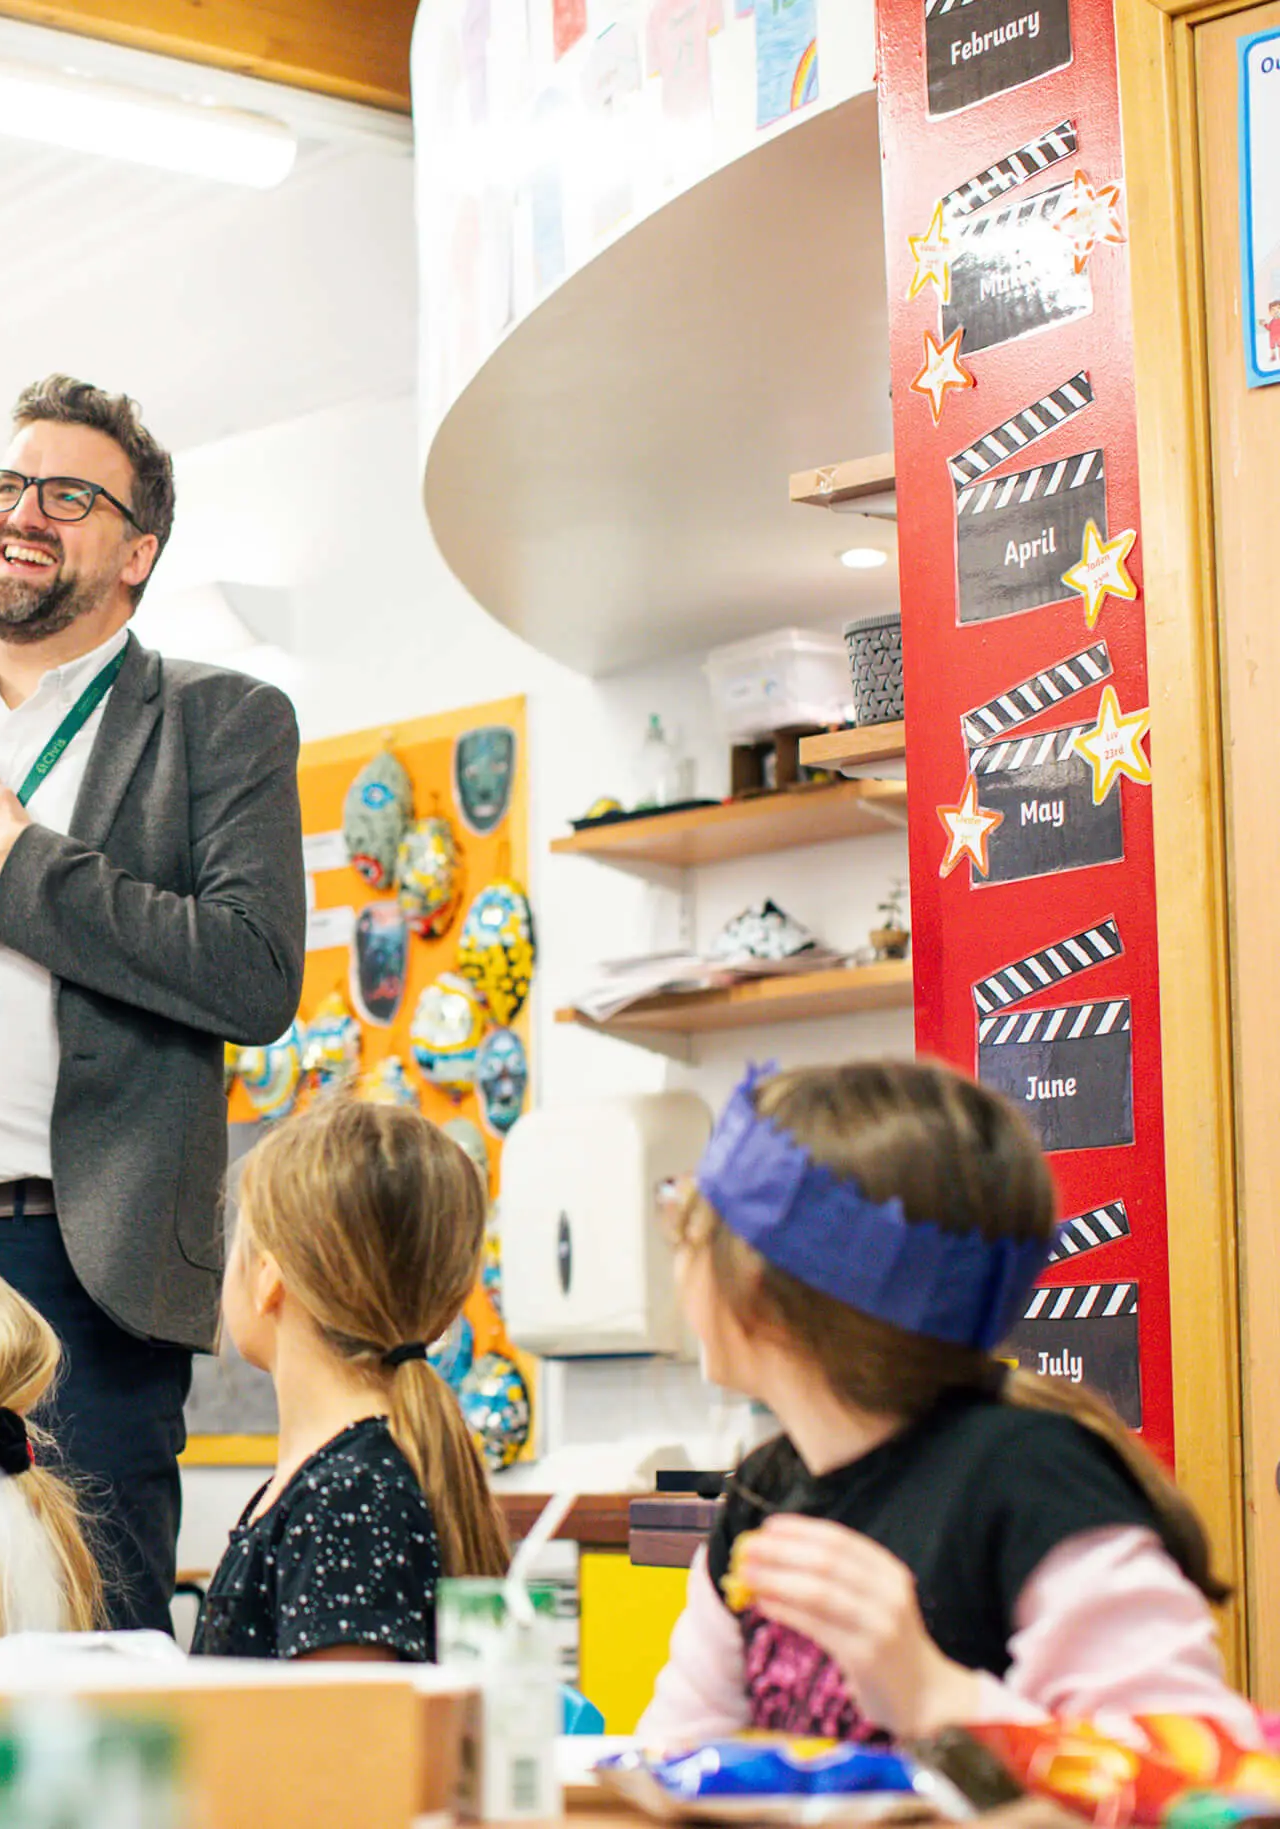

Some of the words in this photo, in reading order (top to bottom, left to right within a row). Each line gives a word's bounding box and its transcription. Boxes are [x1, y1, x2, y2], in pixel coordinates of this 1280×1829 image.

[950, 10, 1041, 66] February
[1004, 527, 1057, 570] April
[1104, 746, 1125, 760] 23rd
[1020, 799, 1065, 827] May
[1025, 1075, 1077, 1101] June
[1037, 1350, 1084, 1384] July
